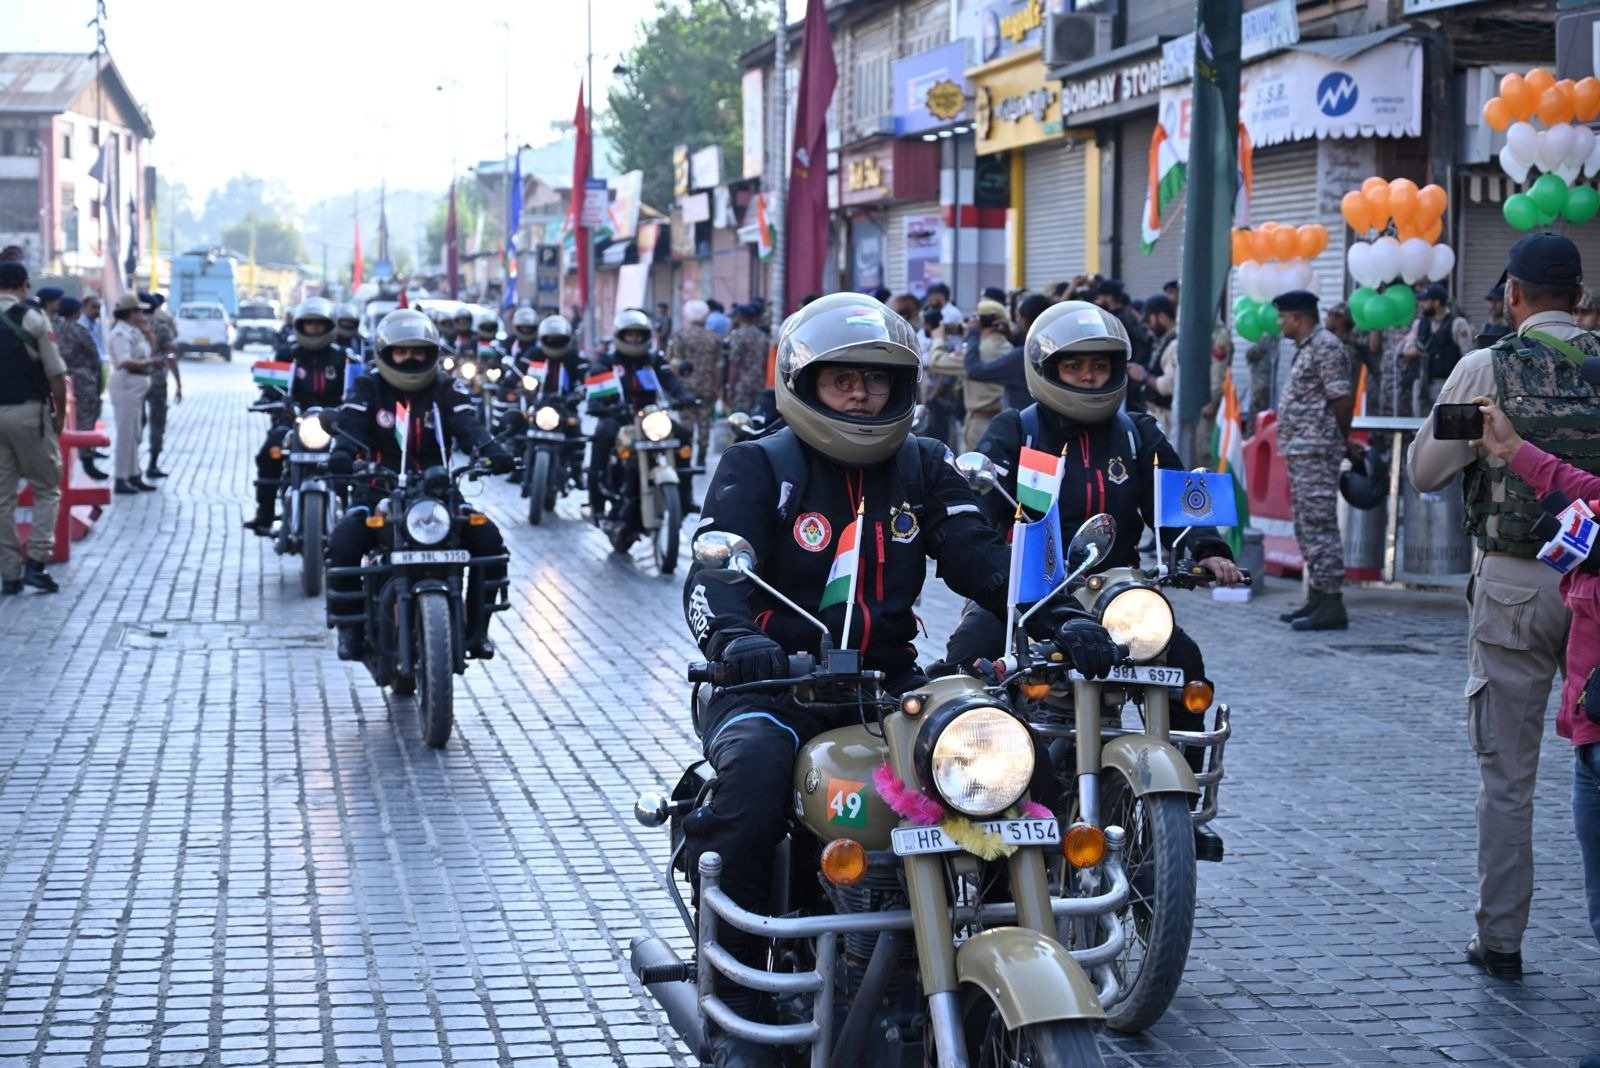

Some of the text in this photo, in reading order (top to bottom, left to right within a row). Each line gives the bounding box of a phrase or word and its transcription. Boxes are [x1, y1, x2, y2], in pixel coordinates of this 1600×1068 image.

[1062, 73, 1116, 116] BOMBAY
[1149, 668, 1182, 684] 6977
[830, 789, 862, 819] 49
[917, 829, 943, 849] HR
[1011, 821, 1057, 841] 5154
